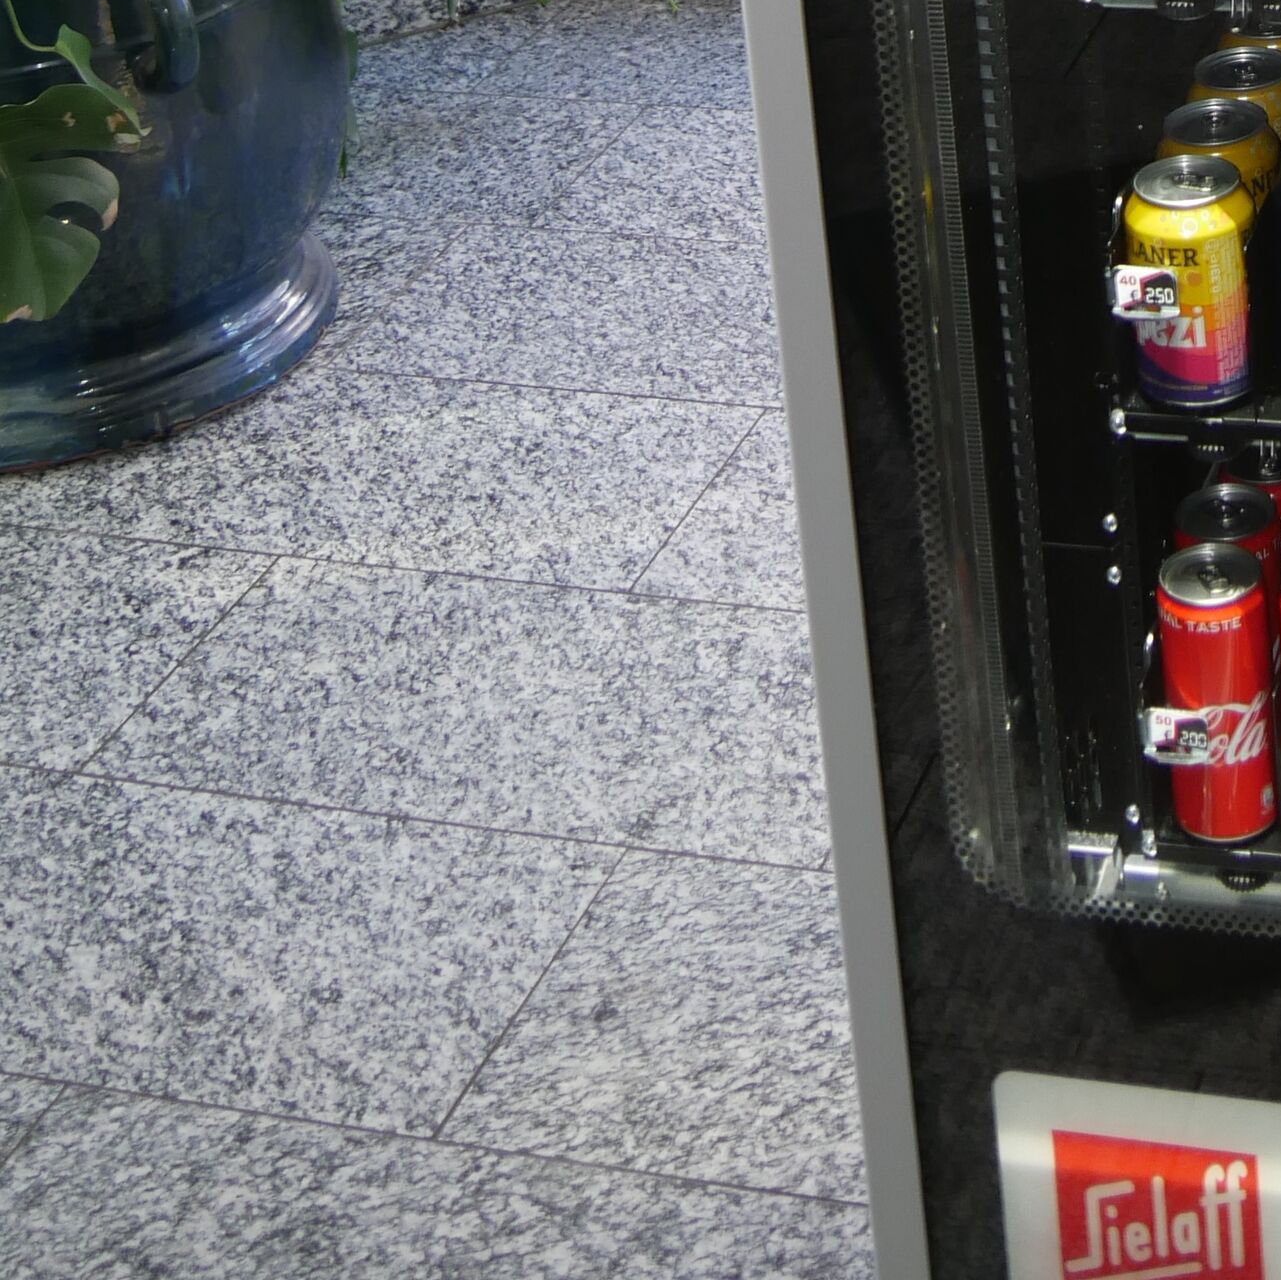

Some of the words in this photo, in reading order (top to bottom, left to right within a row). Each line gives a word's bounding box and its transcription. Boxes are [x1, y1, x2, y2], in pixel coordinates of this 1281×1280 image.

[1120, 275, 1137, 286] 40
[1186, 616, 1242, 633] TASTE
[1155, 715, 1172, 725] 50
[1065, 1160, 1248, 1272] Sielaff
